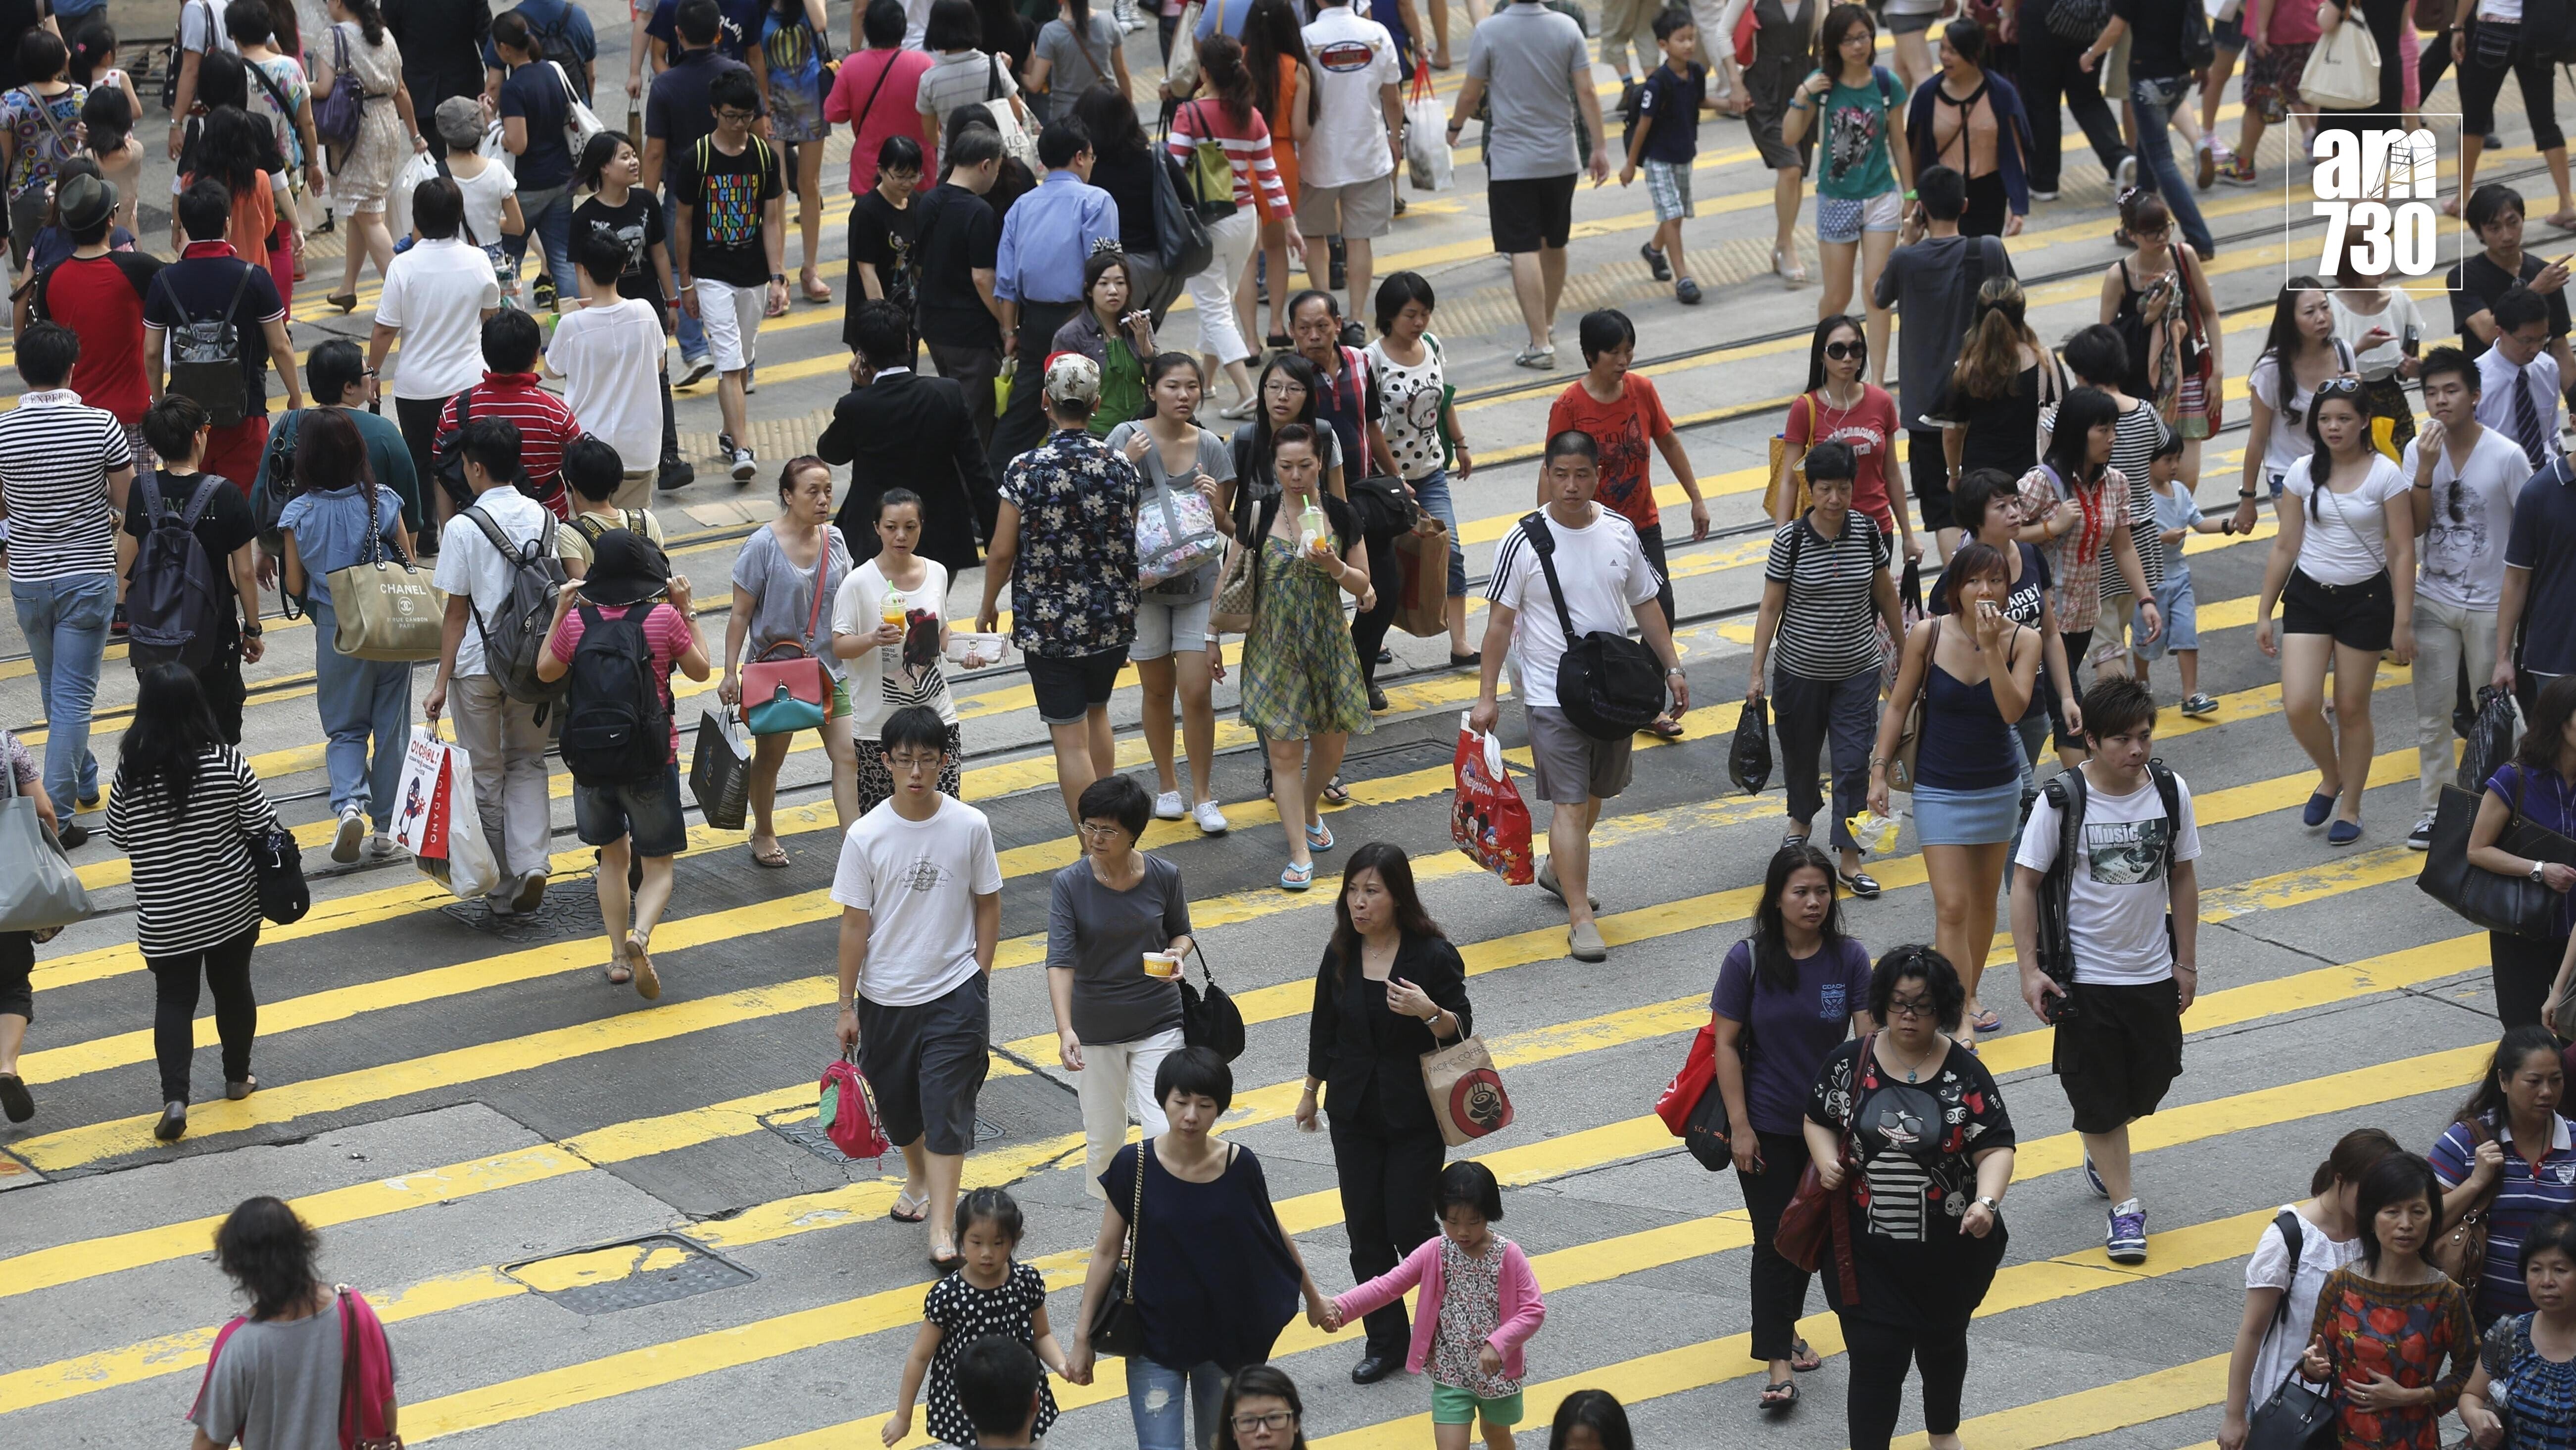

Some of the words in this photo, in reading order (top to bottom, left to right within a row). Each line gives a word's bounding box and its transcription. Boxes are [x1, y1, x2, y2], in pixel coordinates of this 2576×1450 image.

[380, 583, 427, 595] CHANEL
[2006, 582, 2041, 610] ARBY
[2088, 824, 2143, 844] Music.
[1428, 1058, 1456, 1074] PACIFIC
[1458, 1044, 1486, 1061] COFFEE
[1834, 1058, 1848, 1075] MJ
